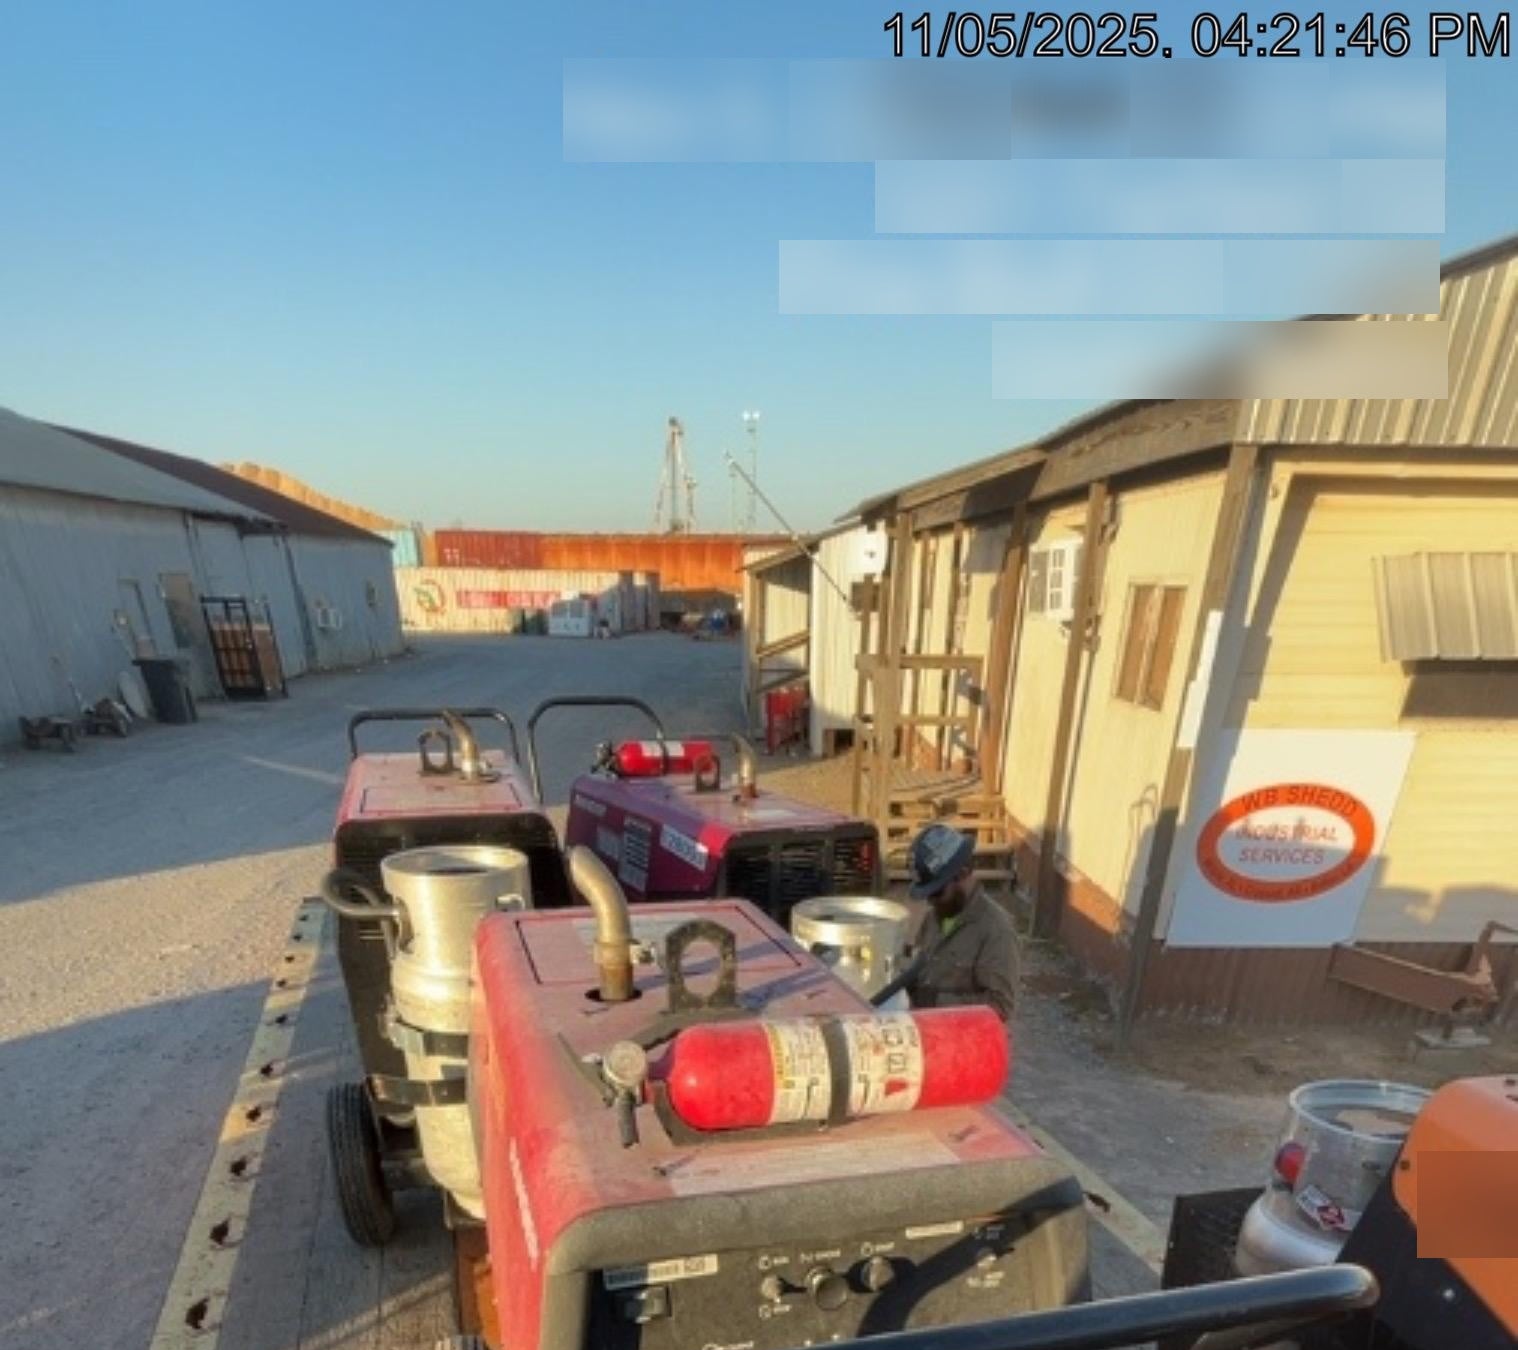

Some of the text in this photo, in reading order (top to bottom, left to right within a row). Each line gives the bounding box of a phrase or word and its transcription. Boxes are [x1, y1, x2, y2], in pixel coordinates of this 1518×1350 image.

[1241, 785, 1358, 816] WB SHEDD
[1238, 848, 1325, 864] SERVICES
